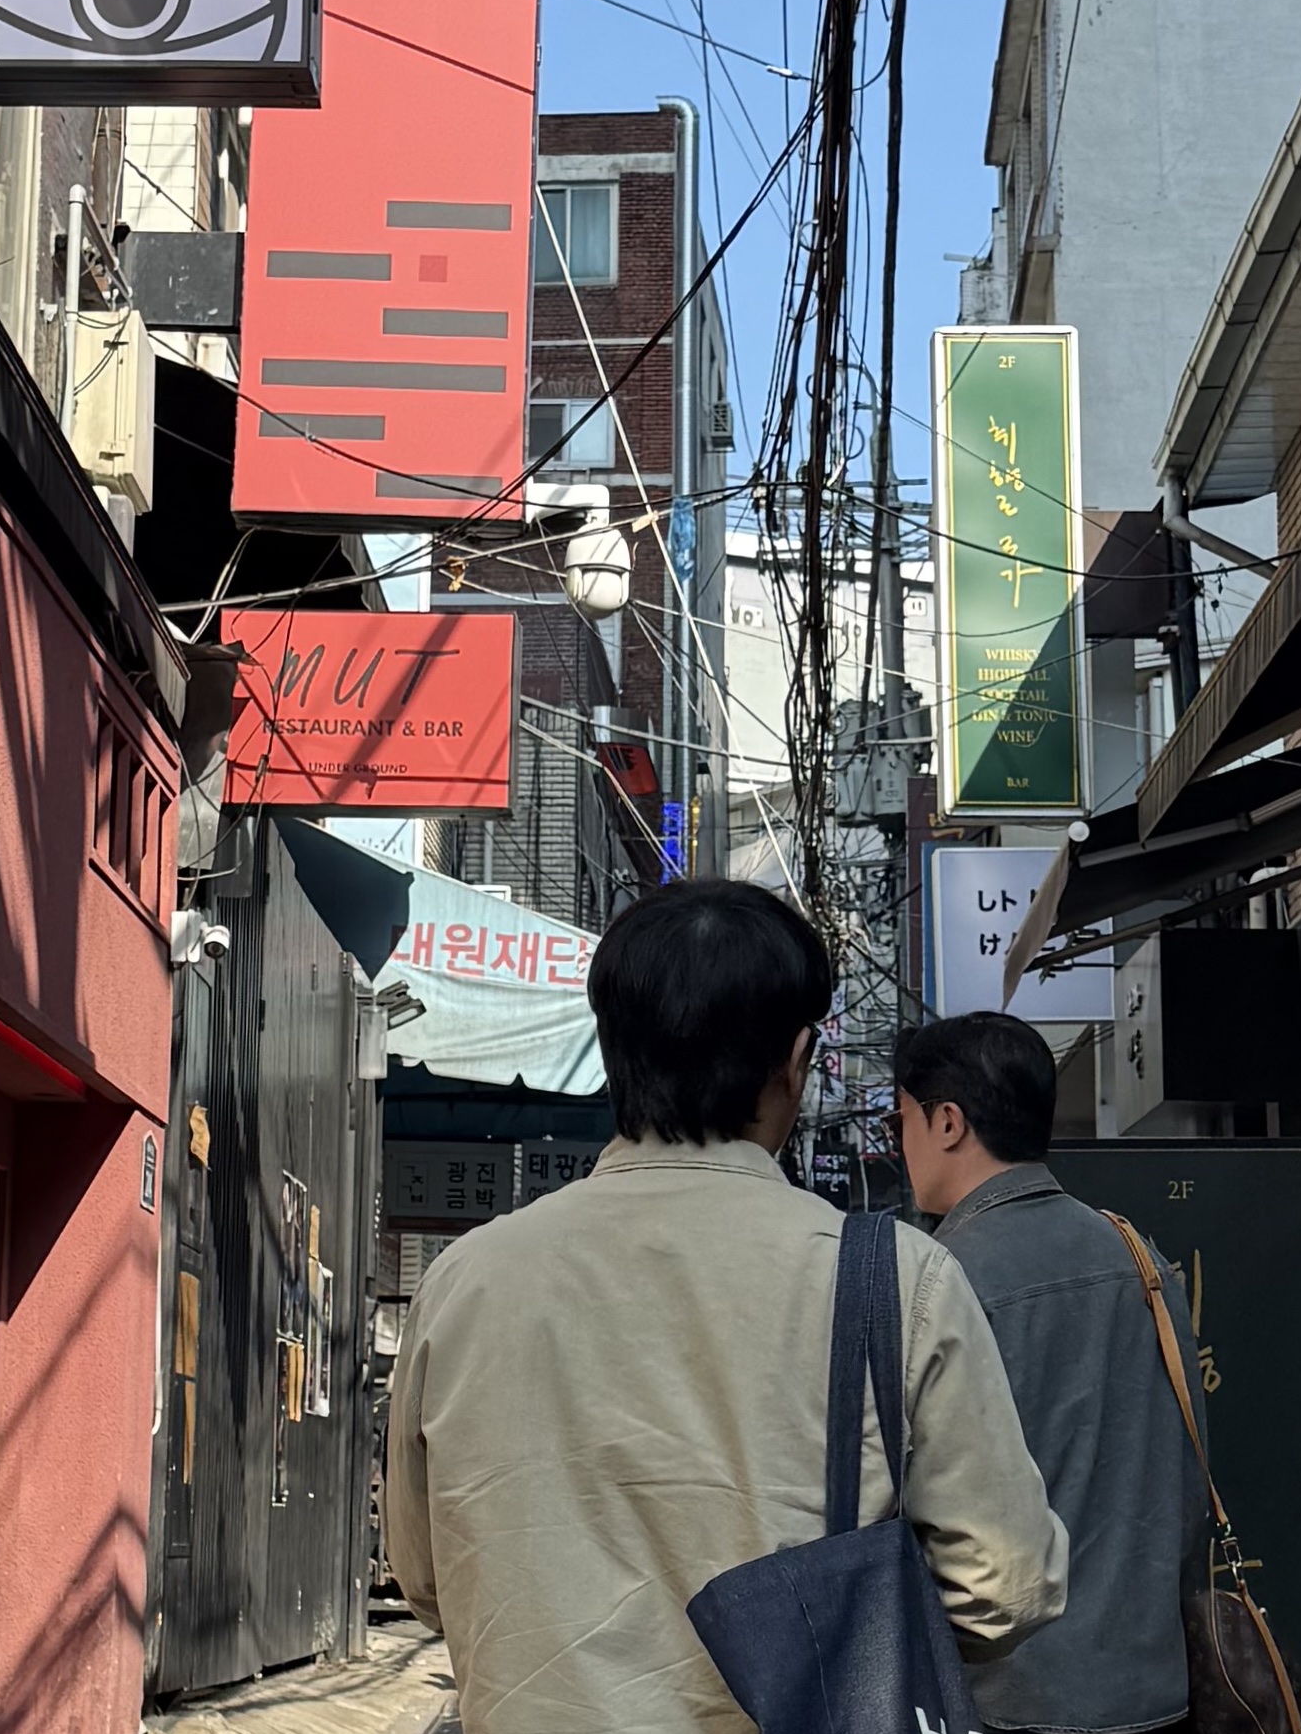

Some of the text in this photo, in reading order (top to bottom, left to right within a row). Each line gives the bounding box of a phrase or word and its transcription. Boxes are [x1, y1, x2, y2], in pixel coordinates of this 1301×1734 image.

[998, 355, 1017, 369] 2F
[980, 689, 1049, 702] COCKTAIL
[972, 710, 997, 722] GIN
[1015, 709, 1058, 722] TONIC
[262, 718, 463, 738] RESTAURANT & BAR
[997, 730, 1035, 743] WINE
[1007, 777, 1030, 788] BAR
[1167, 1180, 1195, 1200] 2F
